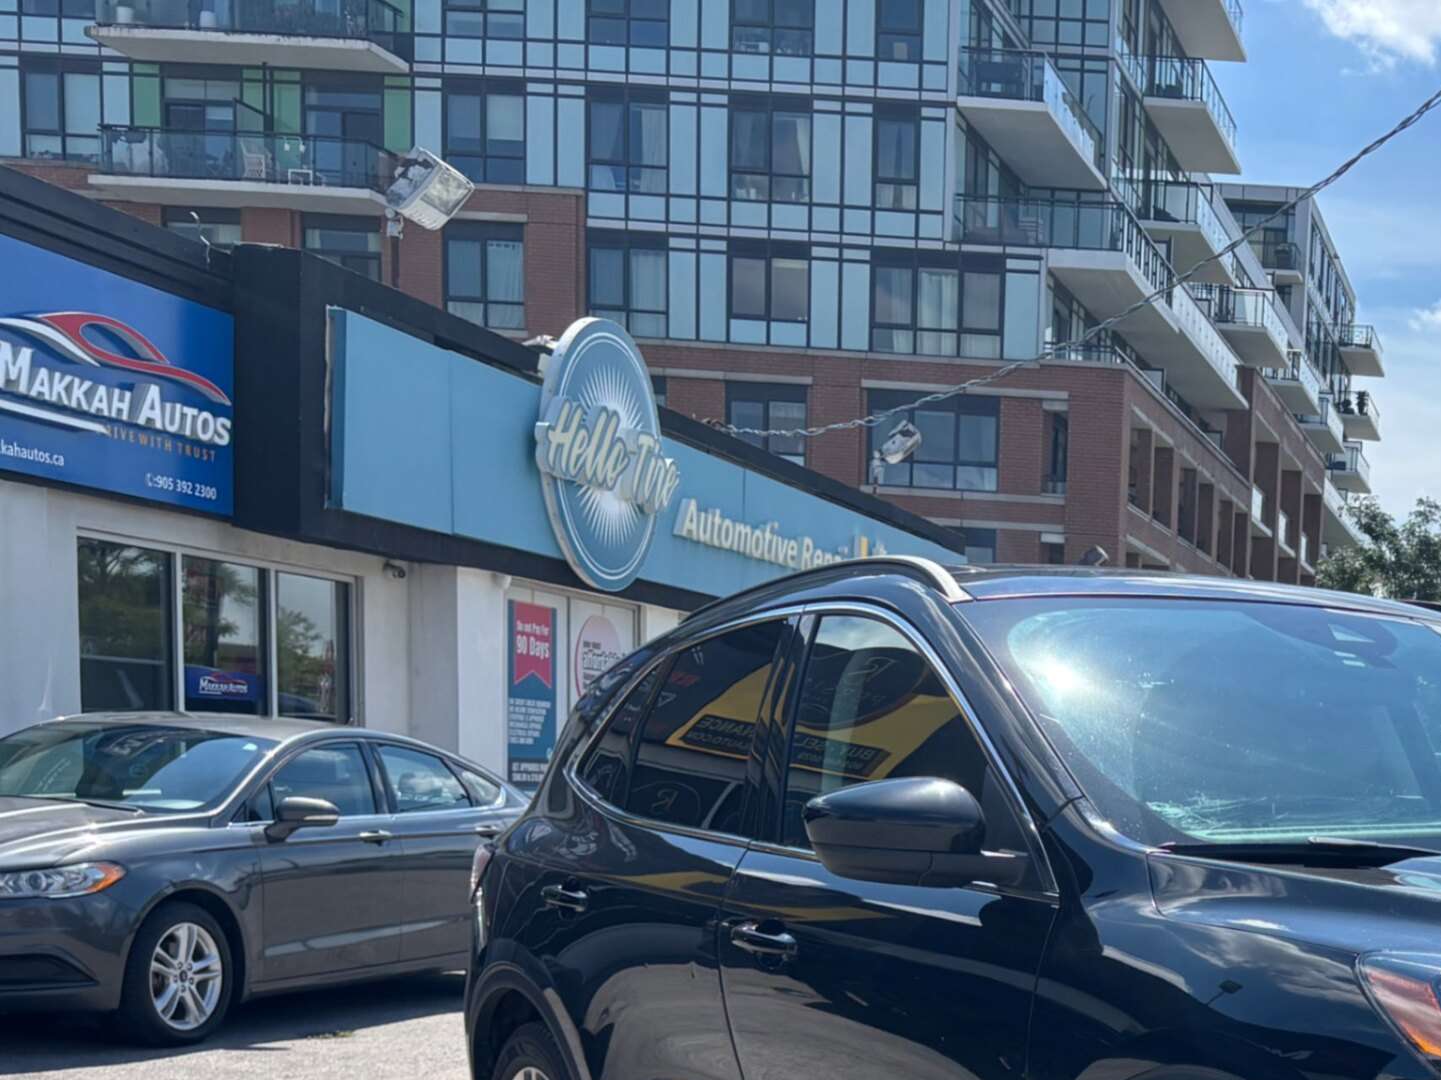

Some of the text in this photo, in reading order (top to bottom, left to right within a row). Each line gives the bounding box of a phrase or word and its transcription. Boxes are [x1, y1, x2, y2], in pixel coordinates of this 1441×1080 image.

[0, 341, 232, 446] MAKKAH AUTOS
[0, 439, 65, 467] kahautos.ca
[176, 442, 216, 463] TRUST
[547, 400, 629, 487] Hello
[175, 479, 193, 495] 392
[194, 483, 217, 500] 2300
[682, 498, 798, 569] Automotive
[516, 634, 550, 660] 90 Days
